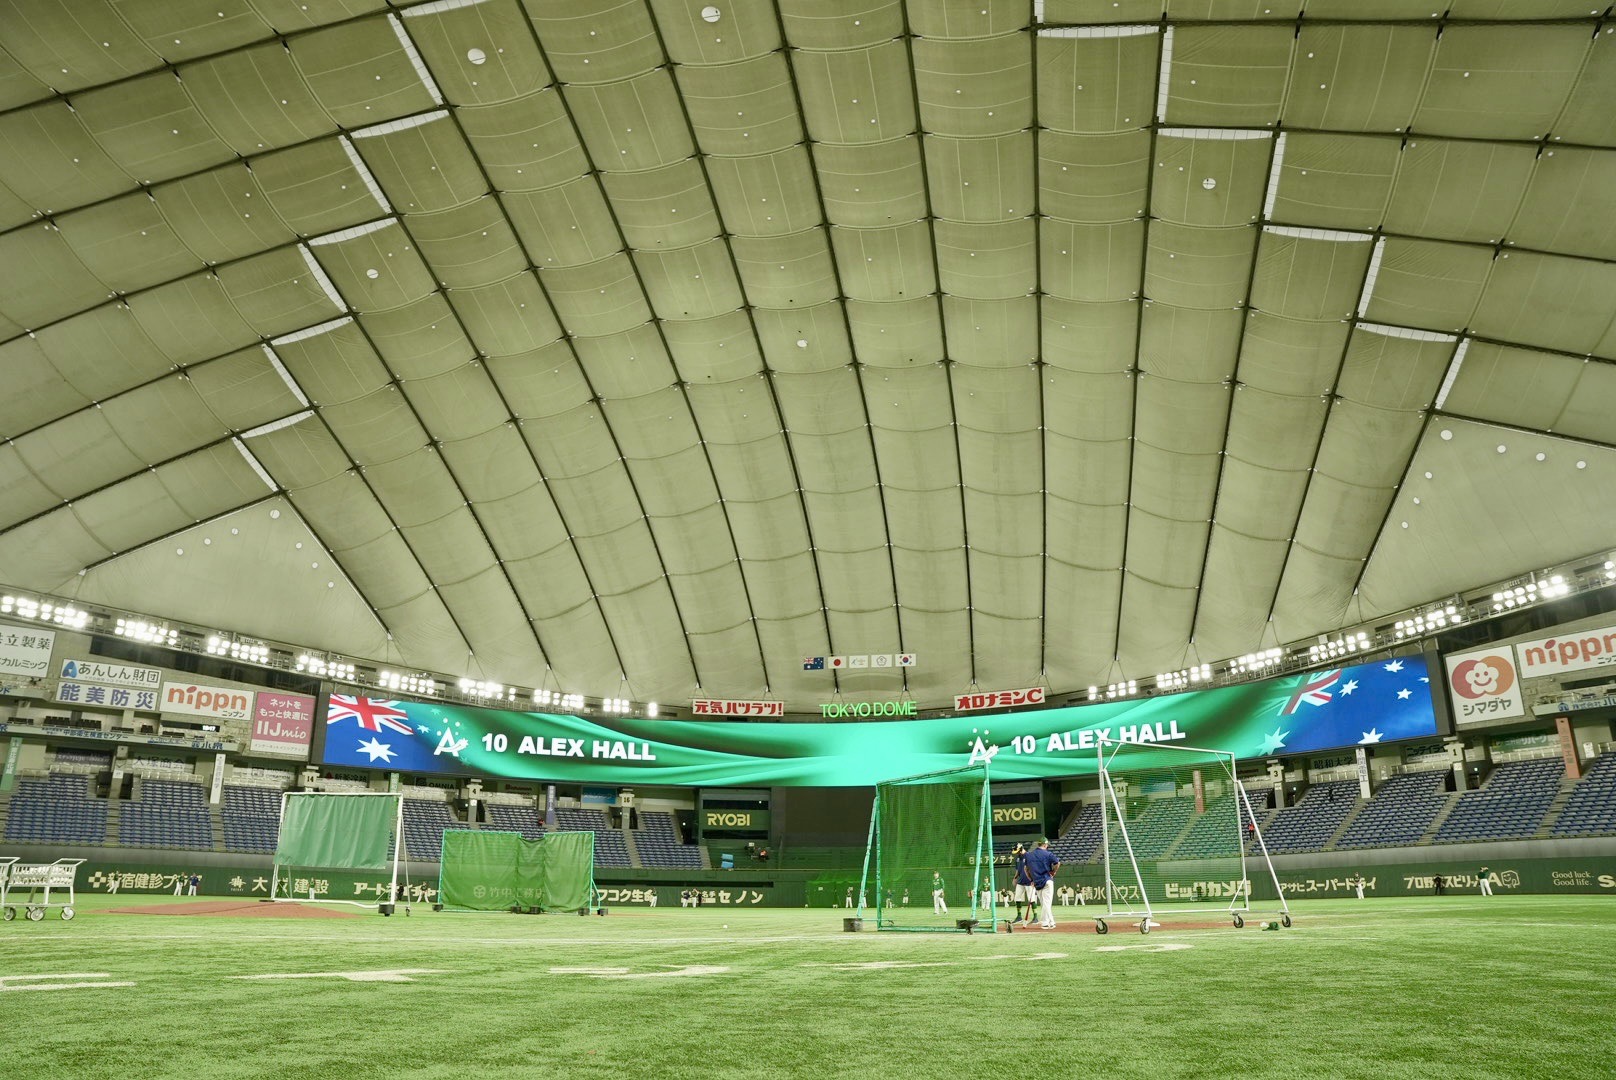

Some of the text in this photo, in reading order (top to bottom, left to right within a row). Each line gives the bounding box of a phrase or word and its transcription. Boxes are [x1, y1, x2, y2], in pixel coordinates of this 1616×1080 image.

[79, 663, 160, 684] あんしん財団
[60, 683, 154, 710] 能美防災
[167, 686, 247, 711] nippn
[270, 698, 302, 709] ネットを
[957, 688, 1043, 710] オロナミンC
[260, 708, 309, 721] もっと快適に
[695, 701, 783, 715] 元気ハツラツ!
[819, 701, 918, 718] TOKYO DOME
[1462, 698, 1512, 717] シマダヤ
[1011, 720, 1186, 755] 10 ALEX HALL
[482, 733, 656, 761] 10 ALEX HALL
[306, 775, 315, 783] 14
[1273, 770, 1279, 778] 3
[707, 813, 751, 827] RYOBI
[993, 807, 1037, 822] RYOBI
[1551, 871, 1573, 879] Good
[1553, 878, 1575, 886] Good
[718, 889, 763, 903] セノン
